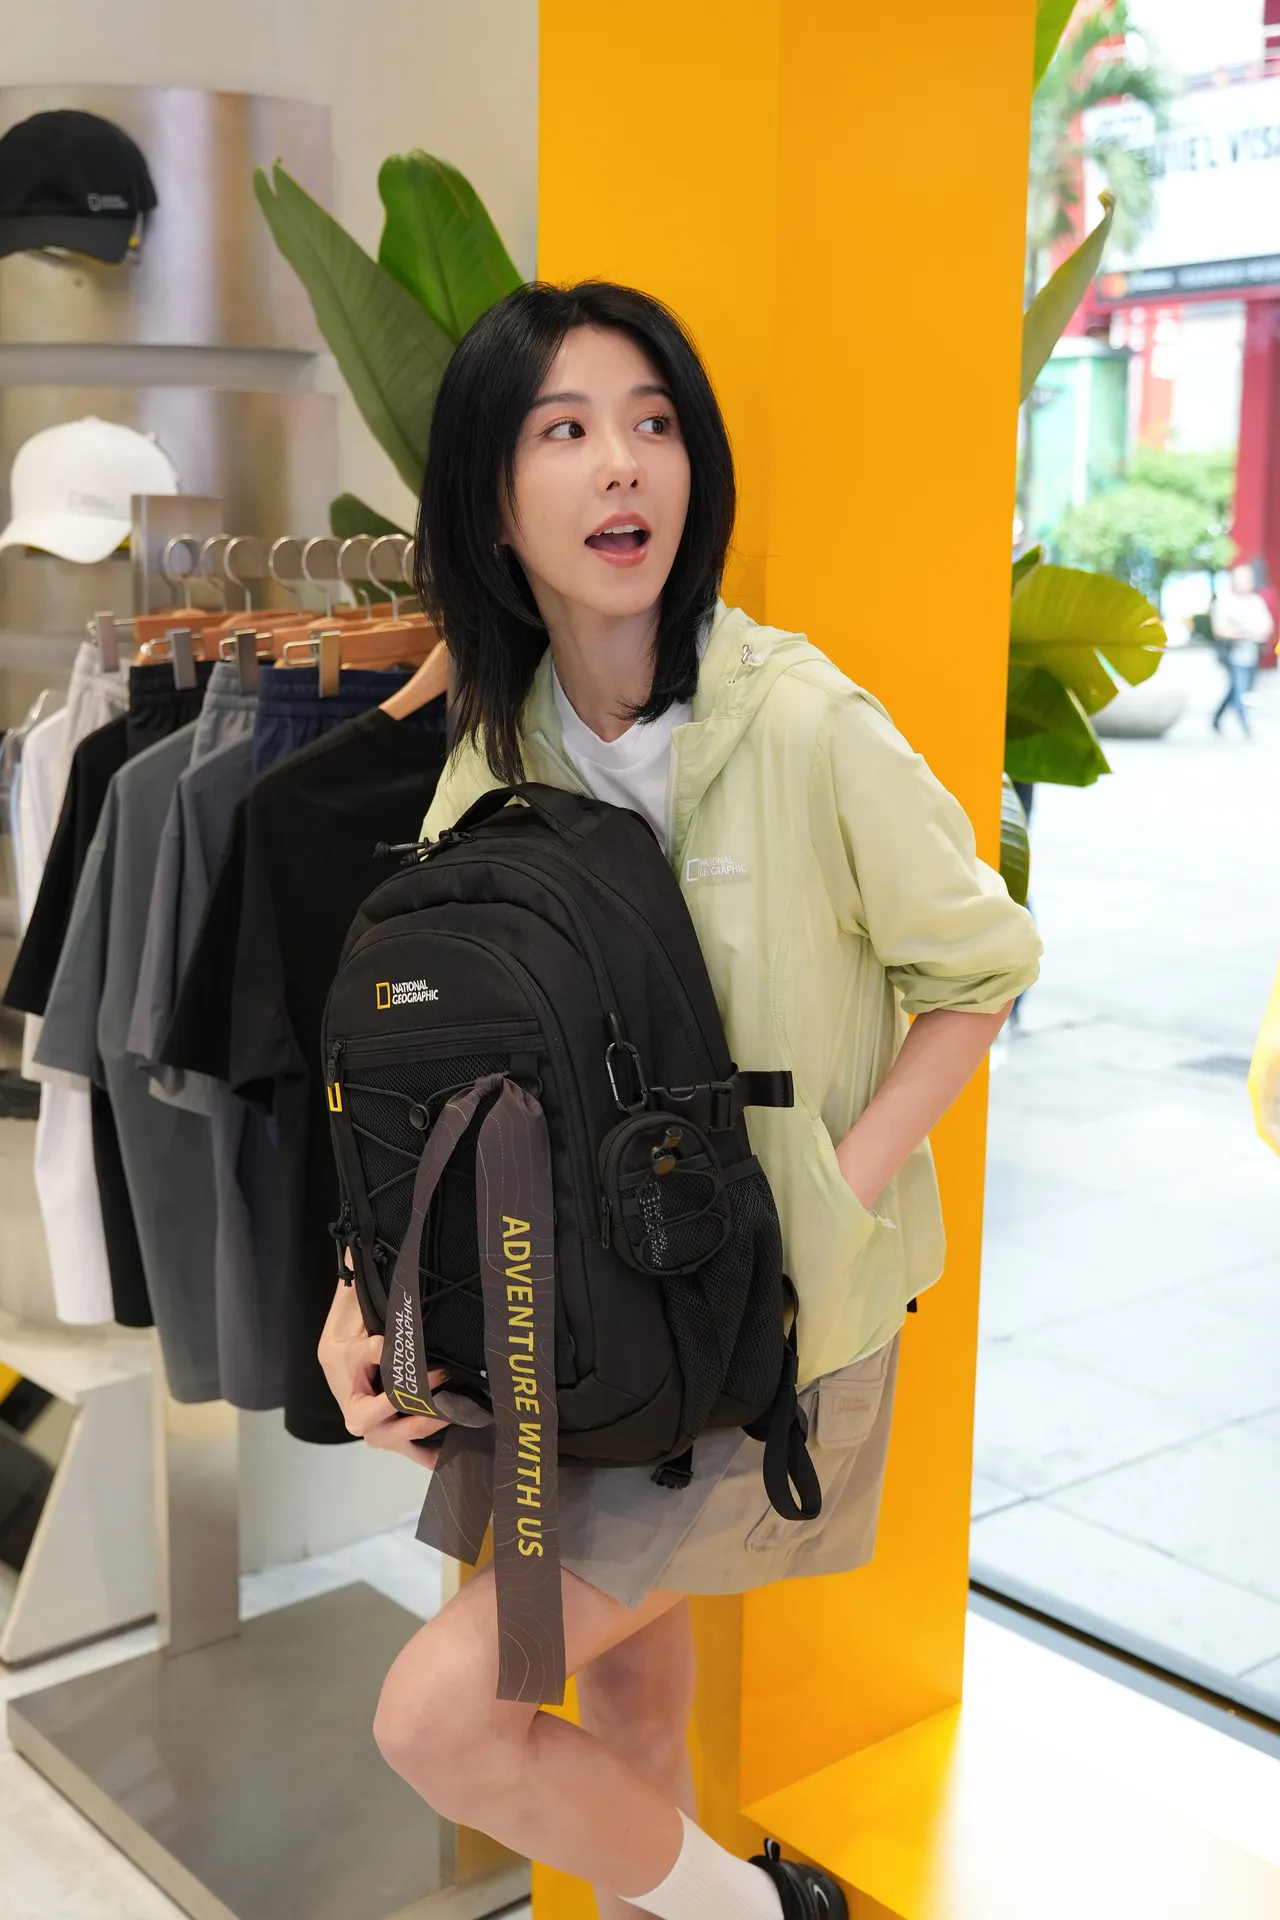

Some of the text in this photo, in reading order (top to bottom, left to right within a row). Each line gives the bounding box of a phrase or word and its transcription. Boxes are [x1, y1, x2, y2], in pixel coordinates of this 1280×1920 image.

[700, 856, 733, 867] NATIONAL
[700, 864, 746, 876] GEOGRAPHIC
[391, 979, 428, 994] NATIONAL
[392, 989, 439, 1005] GEOGRAPHIC
[392, 1310, 406, 1389] NATIONAL
[403, 1291, 418, 1395] GEOGRAPHIC
[502, 1215, 543, 1558] ADVENTURE WITH US
